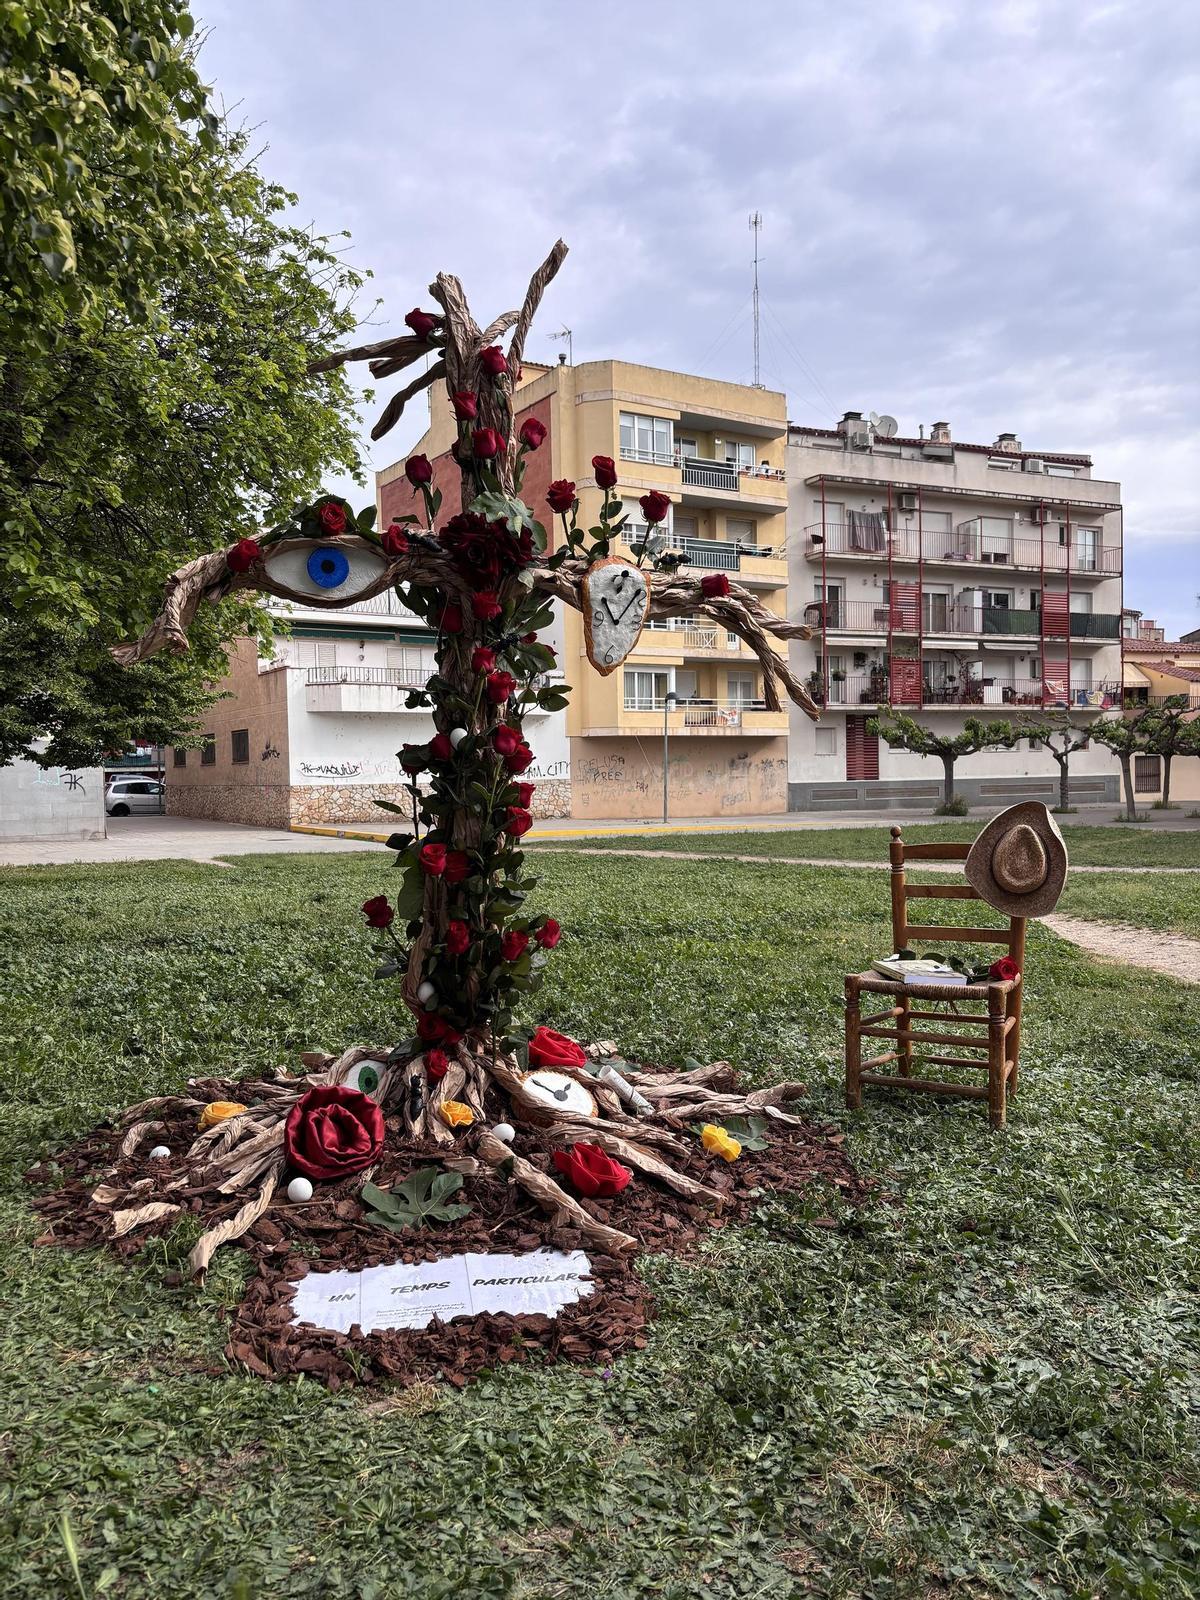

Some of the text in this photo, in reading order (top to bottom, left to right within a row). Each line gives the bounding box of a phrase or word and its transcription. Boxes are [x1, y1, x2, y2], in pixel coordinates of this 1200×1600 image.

[592, 610, 605, 628] 9
[604, 644, 614, 665] 6
[328, 1271, 580, 1303] UN TEMPS PARTICULAR
